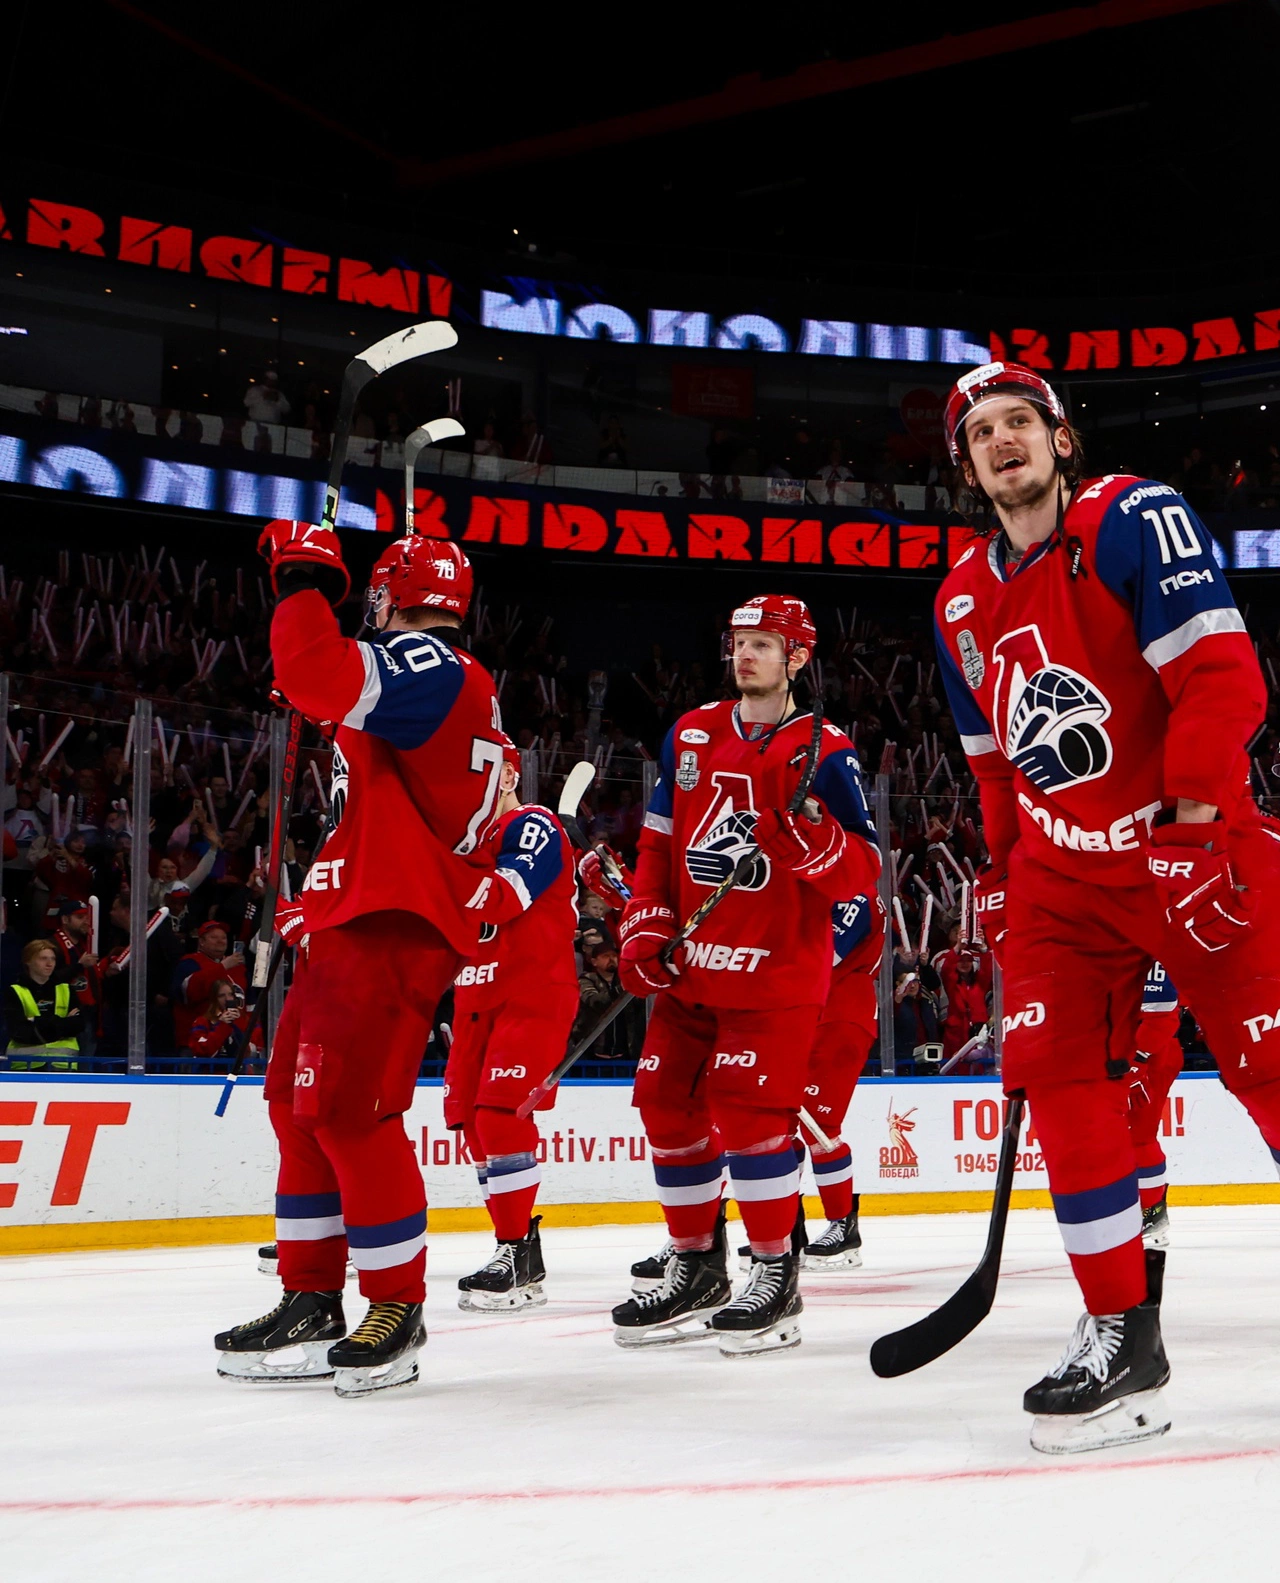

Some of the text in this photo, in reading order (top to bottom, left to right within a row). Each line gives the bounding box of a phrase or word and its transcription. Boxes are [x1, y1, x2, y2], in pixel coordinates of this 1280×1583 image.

[1141, 505, 1203, 565] 10
[1158, 568, 1215, 596] ПСМ
[733, 612, 760, 621] согаз
[518, 821, 550, 856] 87
[879, 1147, 899, 1165] 80
[879, 1168, 919, 1179] ПОБЕДА!
[691, 1281, 721, 1309] CCM
[286, 1308, 322, 1339] CCM
